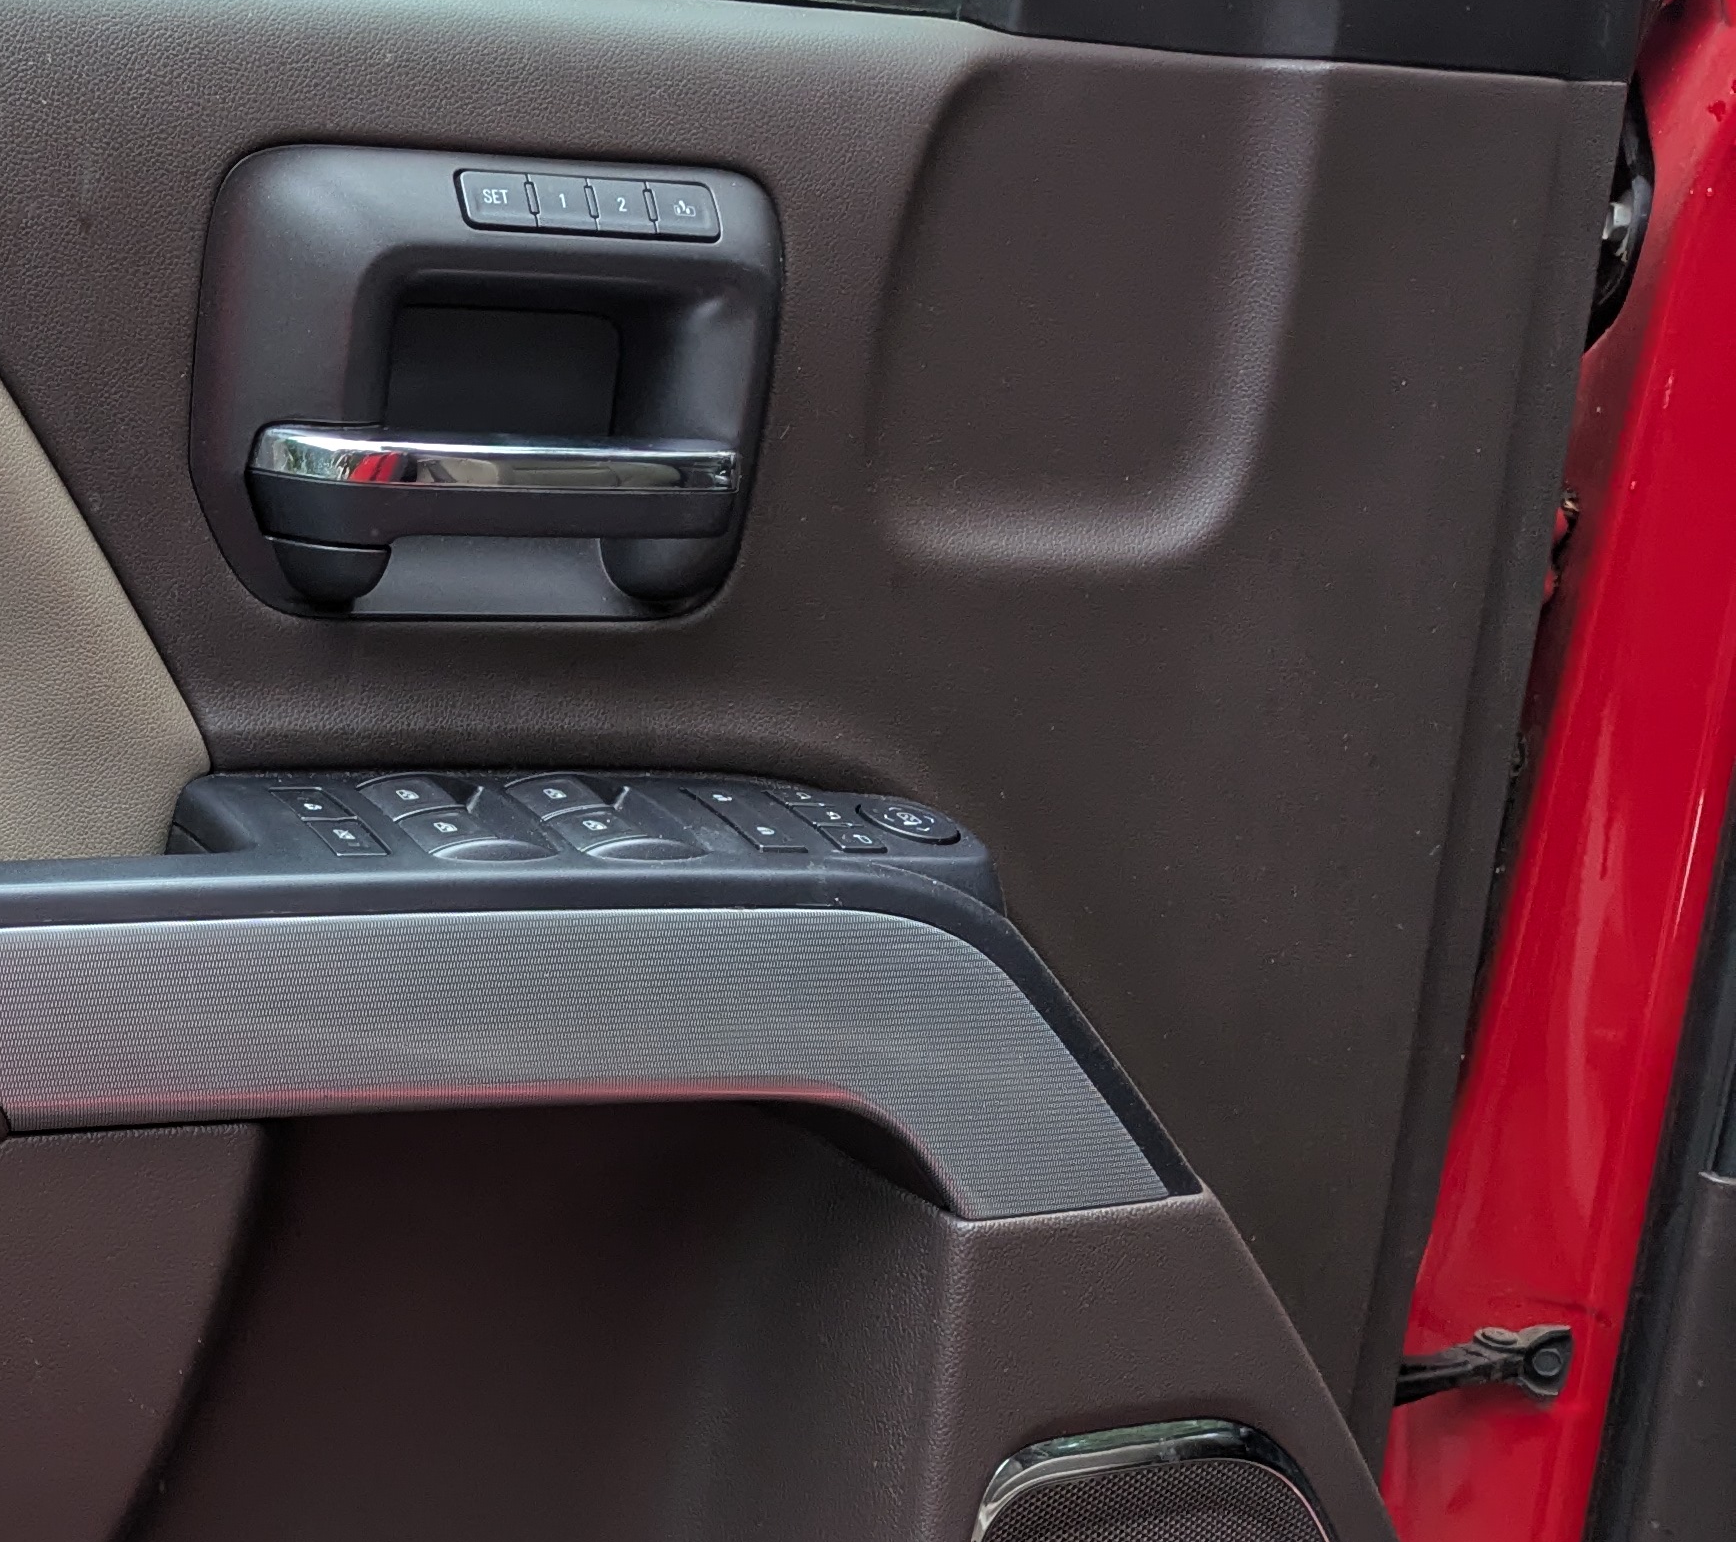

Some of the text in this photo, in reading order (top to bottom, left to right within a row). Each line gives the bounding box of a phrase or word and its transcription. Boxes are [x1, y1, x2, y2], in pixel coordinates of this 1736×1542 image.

[482, 188, 628, 212] SET 1 2
